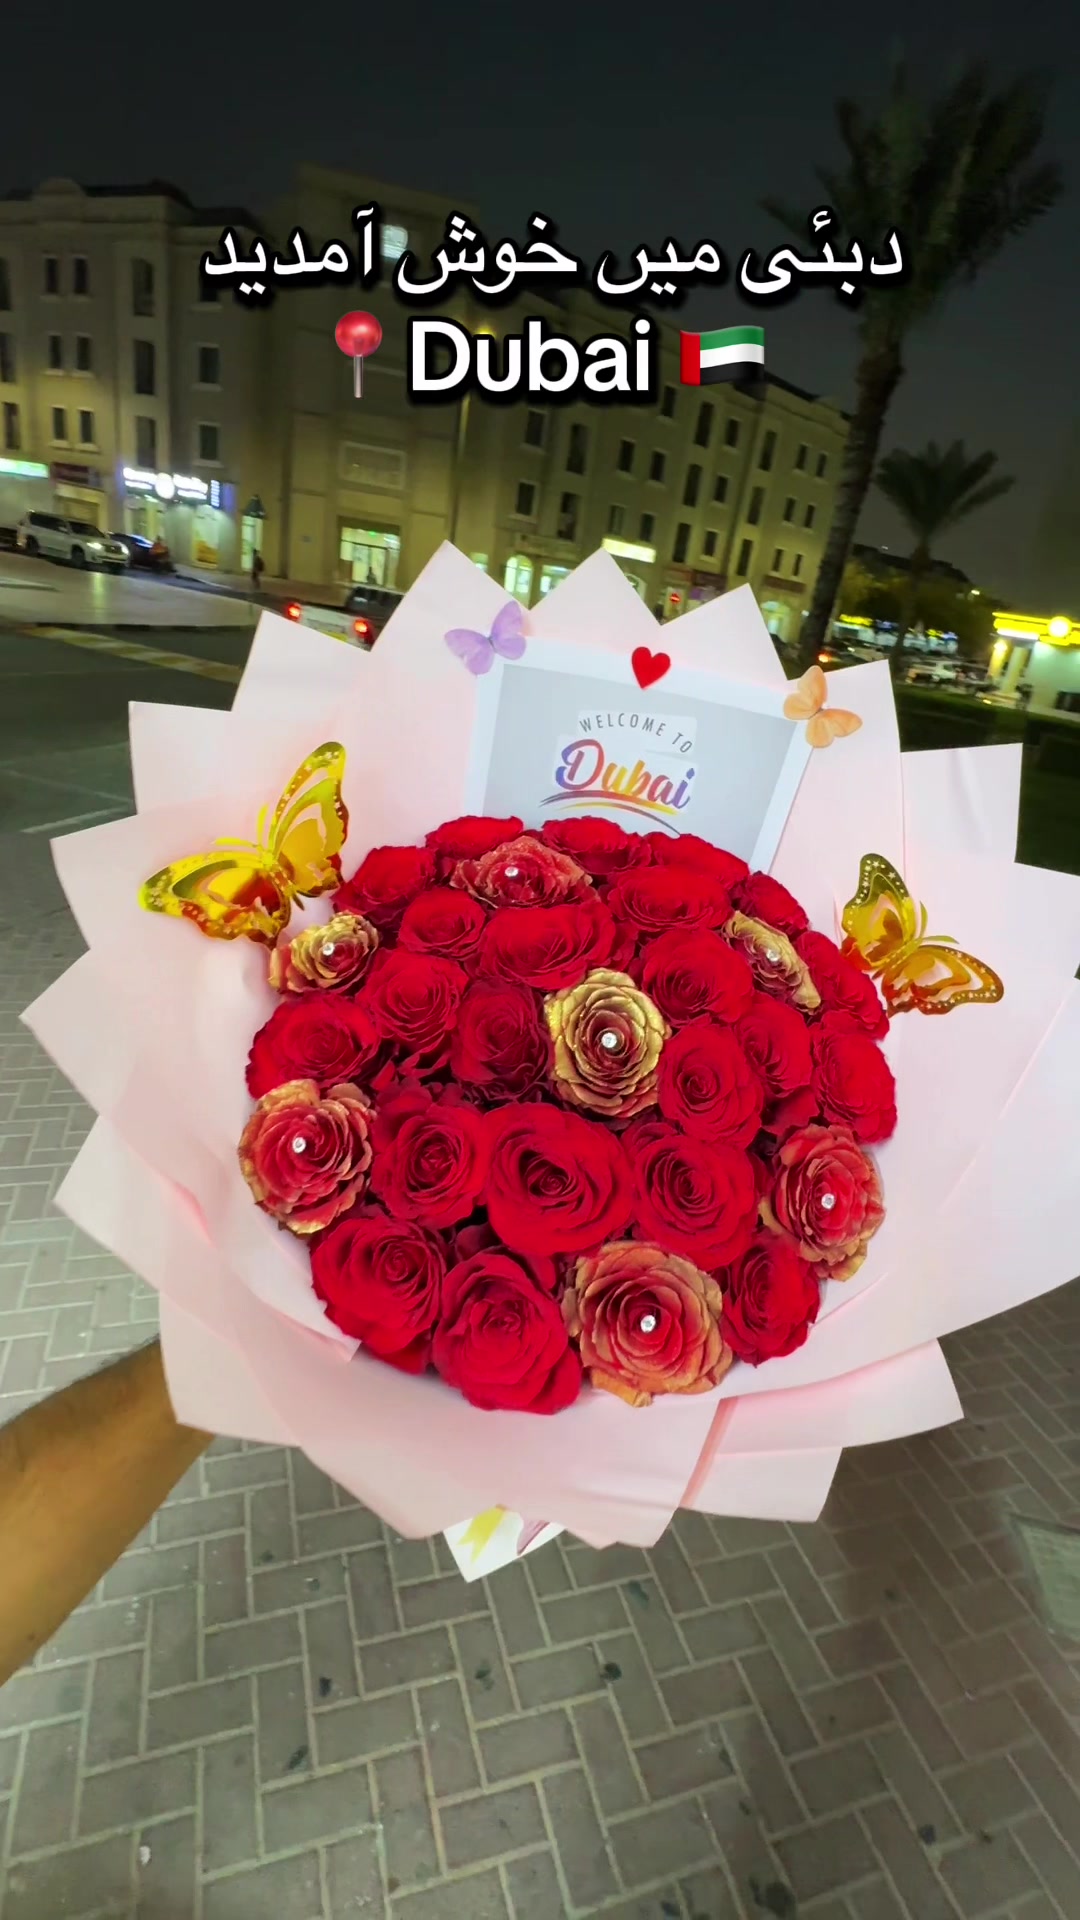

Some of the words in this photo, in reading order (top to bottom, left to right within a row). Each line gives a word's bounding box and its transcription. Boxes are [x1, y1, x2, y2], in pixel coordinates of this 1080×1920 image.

[579, 713, 666, 737] WELCOME
[671, 732, 693, 753] TO
[555, 738, 695, 809] Dubai
